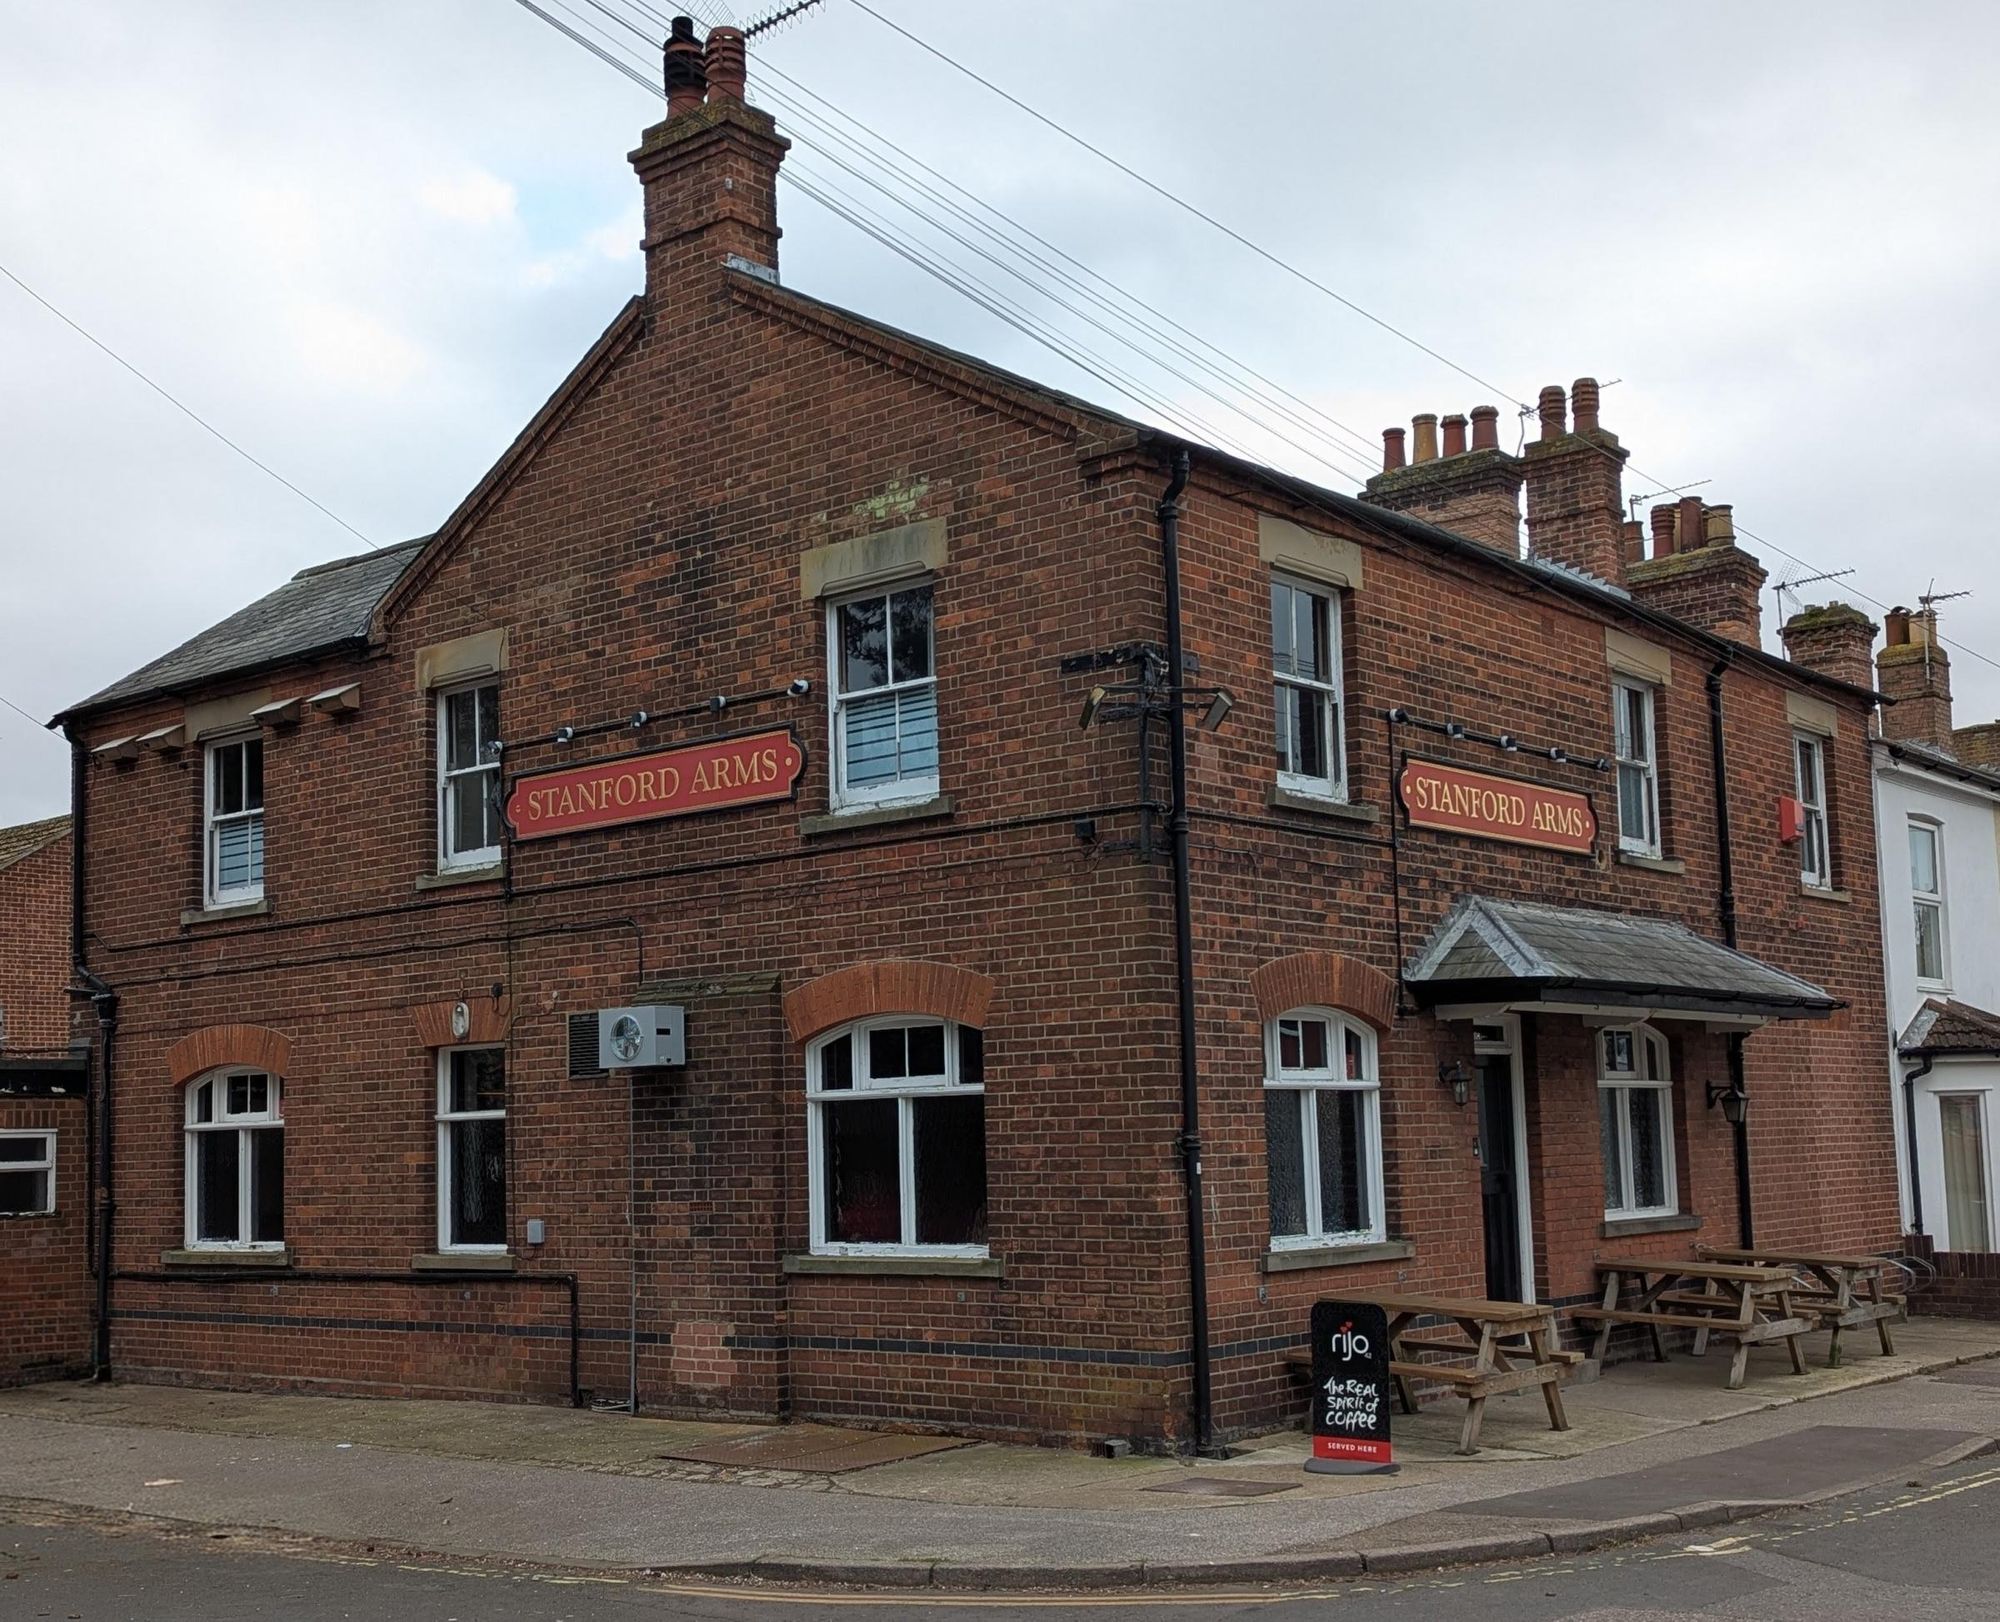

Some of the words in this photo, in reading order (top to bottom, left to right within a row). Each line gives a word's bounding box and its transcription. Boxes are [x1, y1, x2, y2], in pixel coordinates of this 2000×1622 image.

[528, 767, 680, 821] STANFORD
[689, 748, 778, 794] ARMS
[1416, 776, 1525, 826] STANFORD
[1531, 800, 1583, 837] ARMS
[1332, 1330, 1369, 1361] rijo
[1365, 1397, 1380, 1414] of
[1327, 1442, 1356, 1451] SERVED
[1357, 1445, 1377, 1453] HERE
